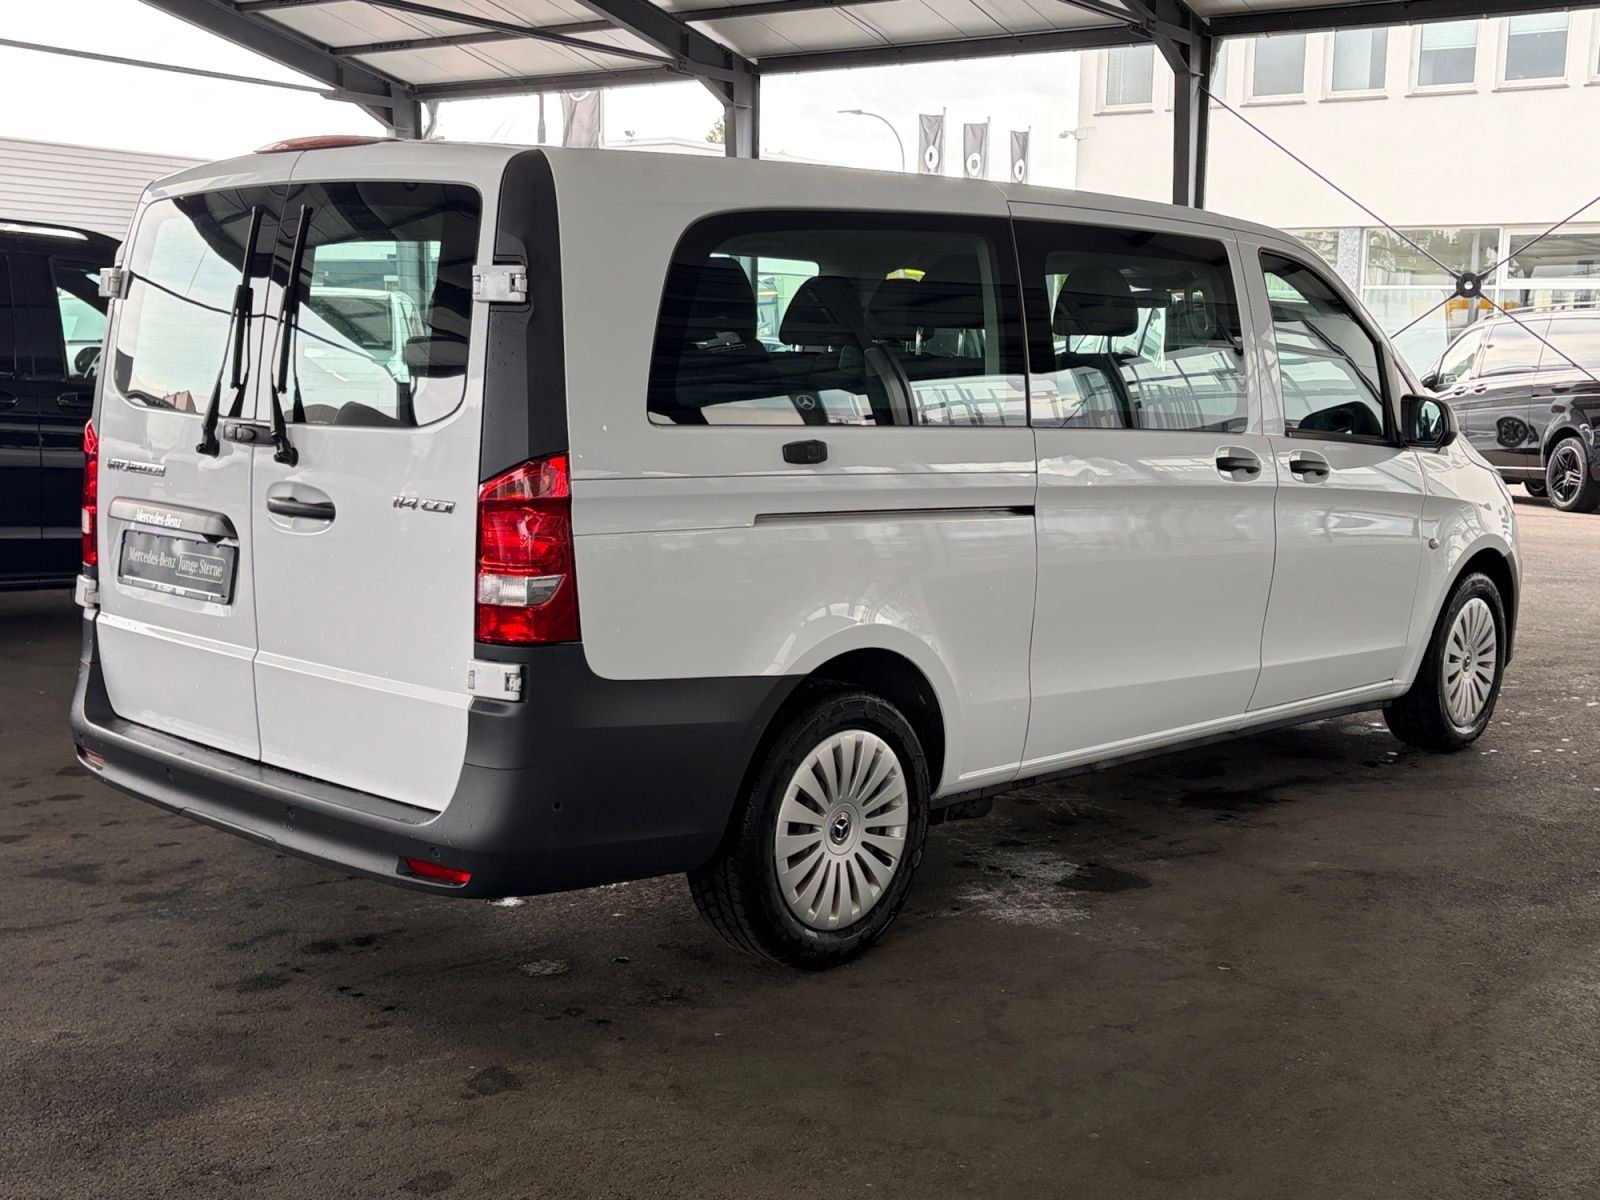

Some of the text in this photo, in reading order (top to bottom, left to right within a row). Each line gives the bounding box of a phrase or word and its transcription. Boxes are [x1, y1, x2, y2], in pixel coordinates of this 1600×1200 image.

[134, 508, 183, 529] Mercedes-Benz
[128, 546, 223, 578] Mercedes-Benz Junge Sterne
